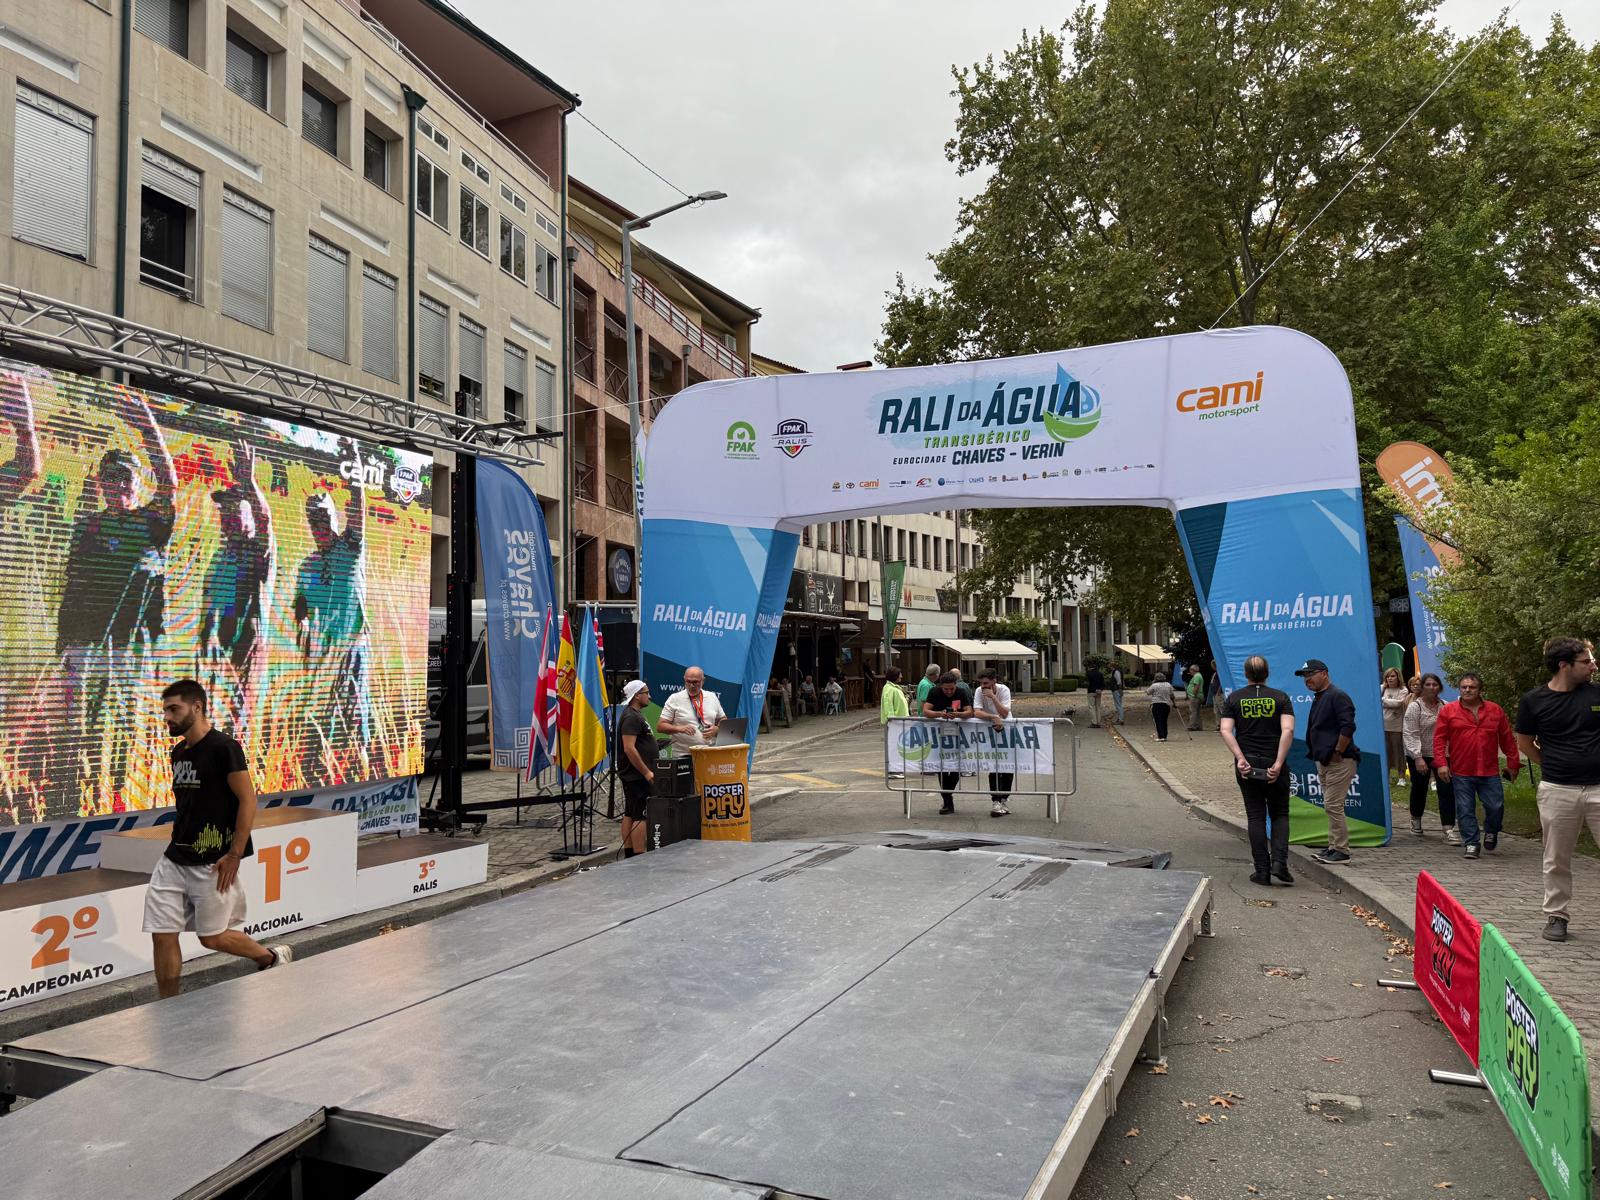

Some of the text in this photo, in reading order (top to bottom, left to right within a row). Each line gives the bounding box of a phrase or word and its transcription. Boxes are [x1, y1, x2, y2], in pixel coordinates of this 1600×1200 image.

[1176, 371, 1264, 413] cami
[878, 382, 1081, 434] RALI DA ÁGUA
[1198, 404, 1260, 421] motorsport
[783, 424, 802, 433] FPAK
[924, 429, 1031, 449] TRANSIBÉRICO
[726, 441, 756, 453] FPAK
[777, 438, 808, 446] RALIS
[893, 455, 947, 465] EUROCIDADE
[952, 447, 1006, 465] CHAVES
[1021, 441, 1065, 461] VERIN
[859, 479, 880, 489] cami
[653, 604, 747, 631] RALI DA ÁGUA
[1221, 600, 1271, 624] RALI
[1273, 603, 1289, 616] DA
[1290, 593, 1354, 619] ÁGUA
[674, 623, 724, 637] TRANSIBÉRICO
[1253, 620, 1322, 632] TRANSIBÉRICO
[1242, 704, 1275, 718] PLAY
[704, 784, 743, 797] POSTER
[705, 794, 744, 818] PLAY
[257, 837, 311, 905] 1º
[418, 859, 436, 880] 3º
[412, 879, 438, 895] RALIS
[243, 911, 304, 936] NACIONAL
[1431, 906, 1453, 948] POSTER
[31, 906, 99, 970] 2º
[0, 963, 114, 1002] CAMPEONATO
[1505, 985, 1537, 1047] POSTER
[1506, 1013, 1538, 1098] PLAY
